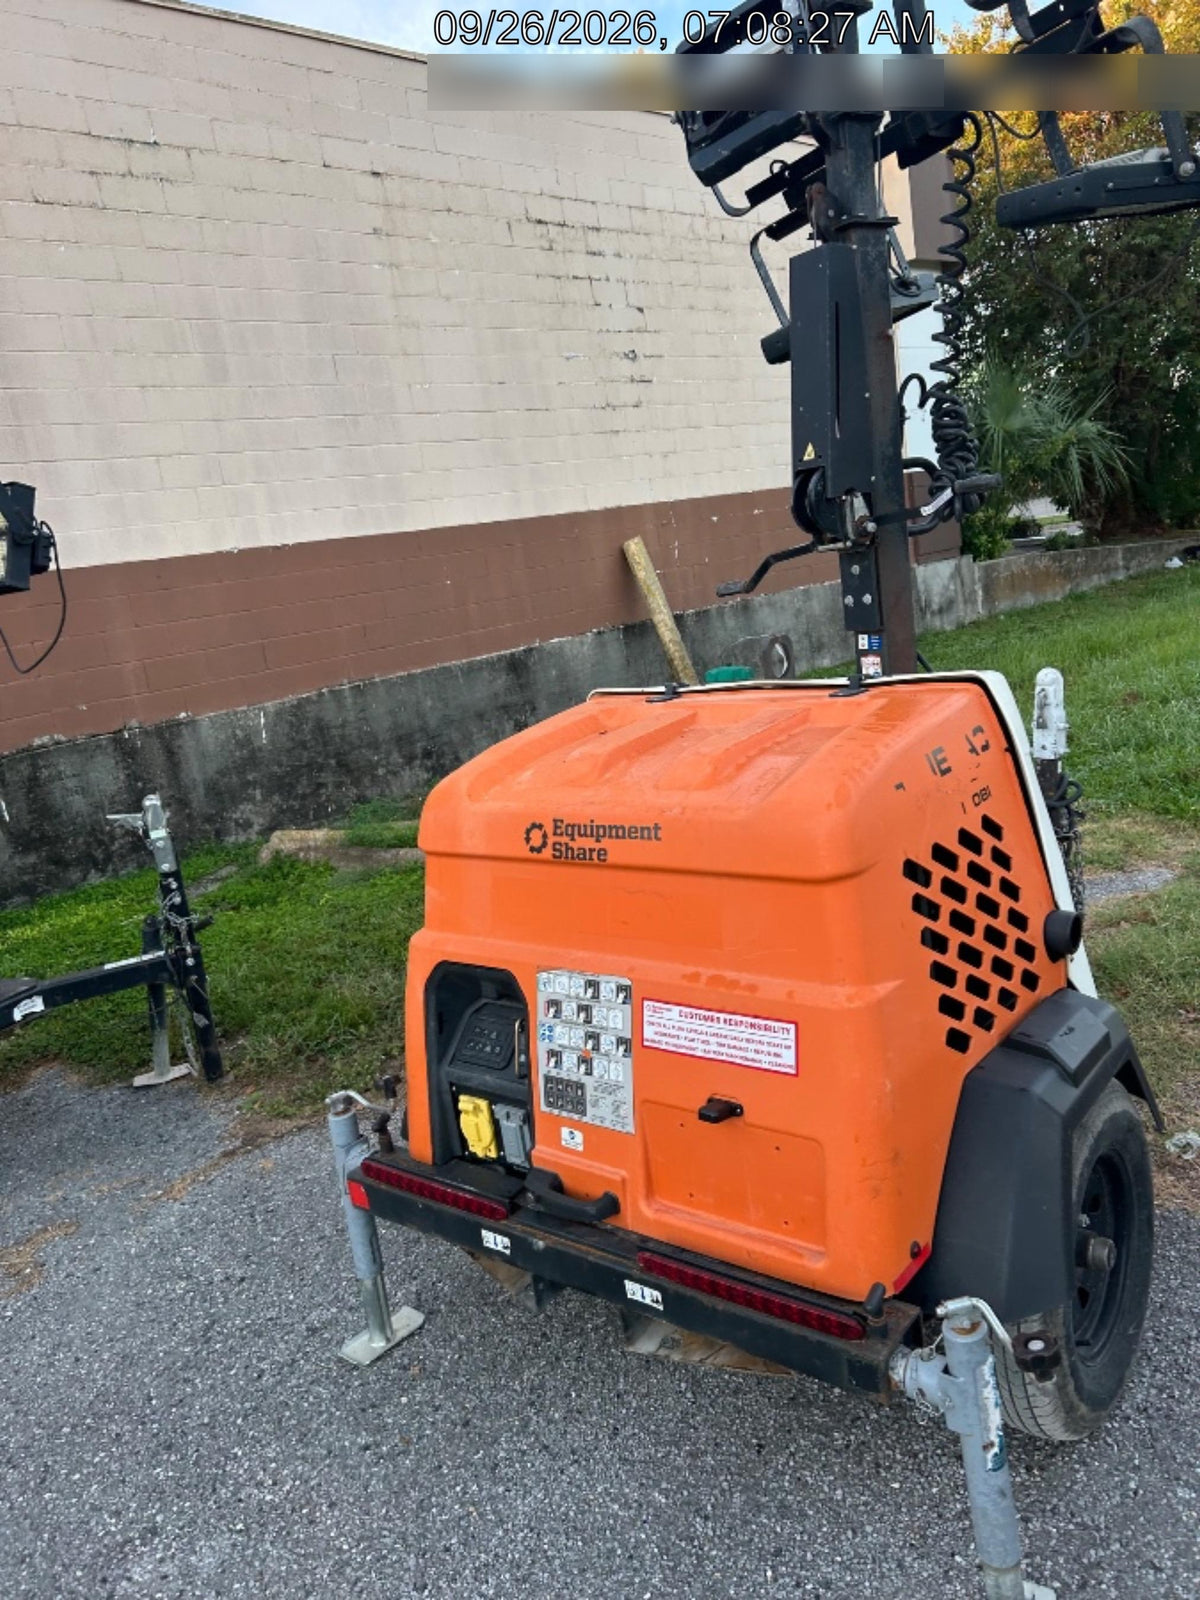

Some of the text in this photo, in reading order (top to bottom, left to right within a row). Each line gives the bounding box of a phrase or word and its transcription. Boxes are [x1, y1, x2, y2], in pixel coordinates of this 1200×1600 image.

[552, 818, 662, 842] Equipment
[552, 841, 608, 862] Share
[679, 1010, 721, 1024] CUSTOMER
[723, 1017, 791, 1035] RESPONSIBILITY
